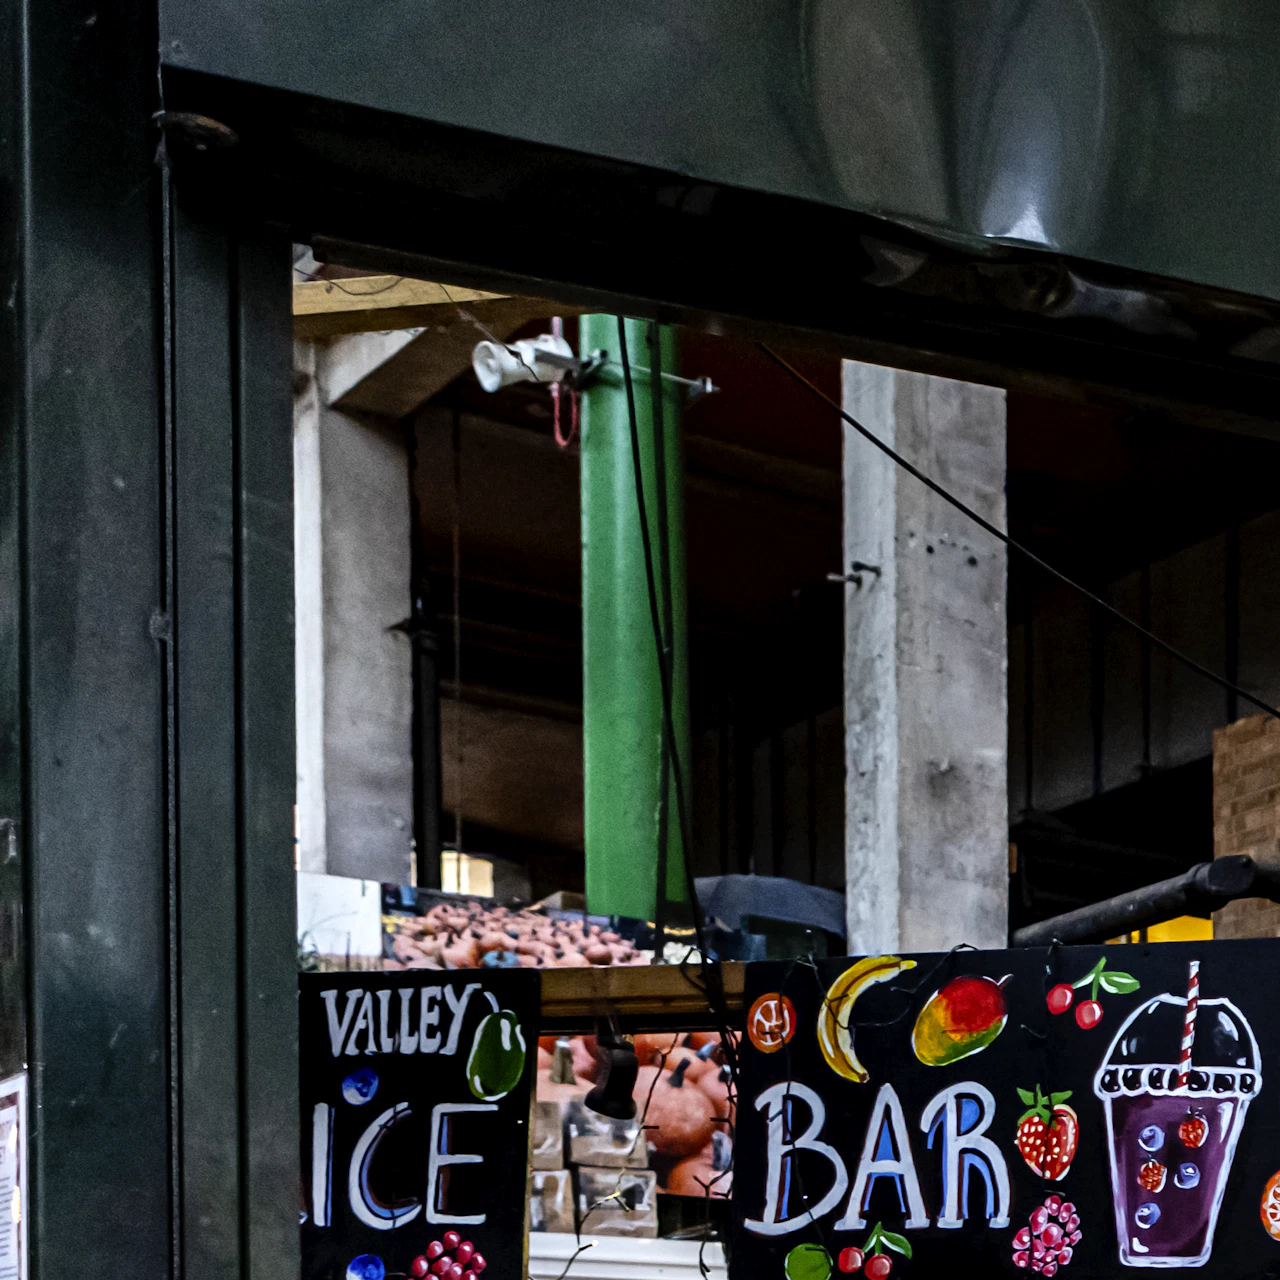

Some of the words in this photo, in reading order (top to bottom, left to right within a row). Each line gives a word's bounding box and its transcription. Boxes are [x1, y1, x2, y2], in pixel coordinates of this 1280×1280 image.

[320, 982, 483, 1058] VALLEY
[301, 1102, 500, 1230] ICE
[744, 1081, 1011, 1233] BAR
